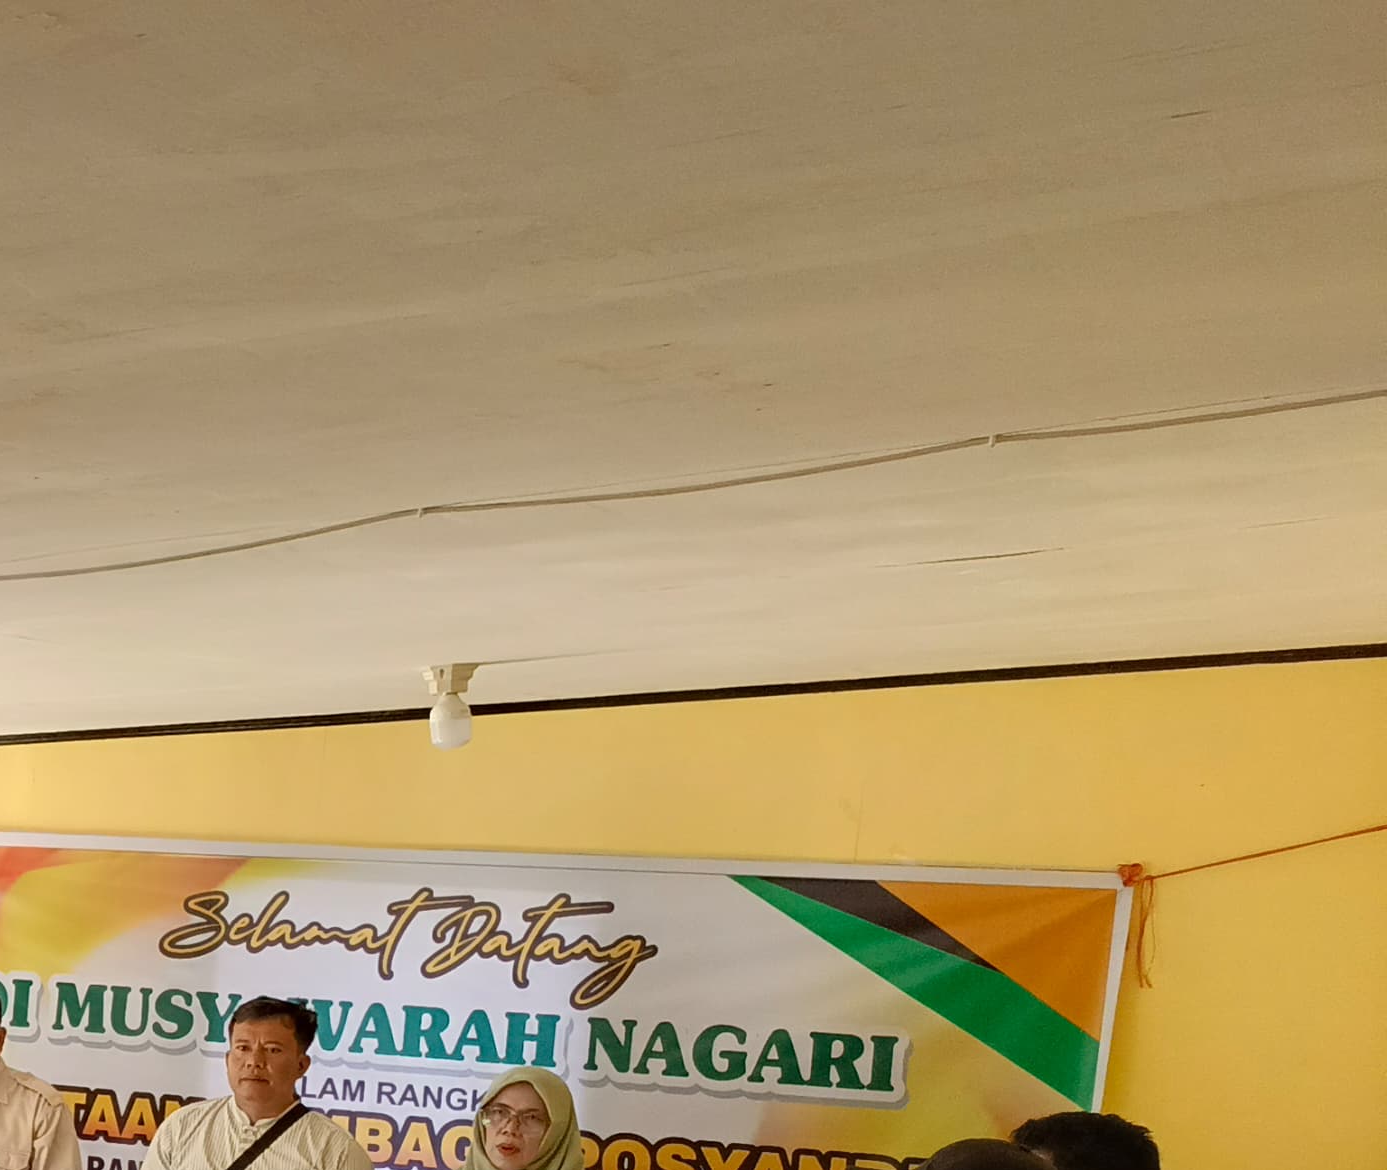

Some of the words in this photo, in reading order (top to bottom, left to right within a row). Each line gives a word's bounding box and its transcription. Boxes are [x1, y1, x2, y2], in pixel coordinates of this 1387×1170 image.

[159, 887, 475, 980] Selamat
[421, 893, 658, 1010] Datang
[583, 1017, 899, 1092] NAGARI
[301, 1076, 365, 1103] LAM
[378, 1081, 484, 1112] RANGK
